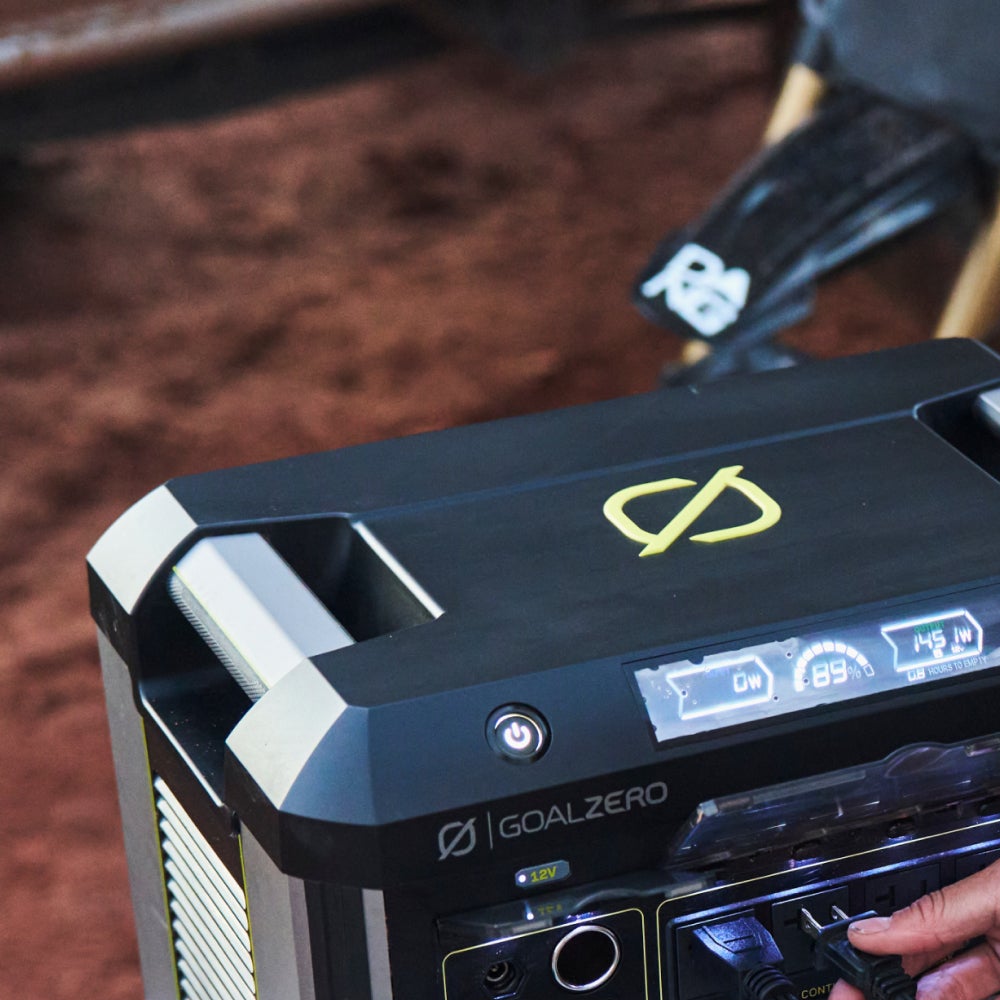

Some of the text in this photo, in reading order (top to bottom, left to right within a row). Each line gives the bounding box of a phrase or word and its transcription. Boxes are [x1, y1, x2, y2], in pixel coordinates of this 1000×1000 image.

[927, 662, 953, 676] HOURS
[953, 659, 964, 671] TO
[963, 655, 988, 669] EMPTY
[530, 866, 557, 883] 12V
